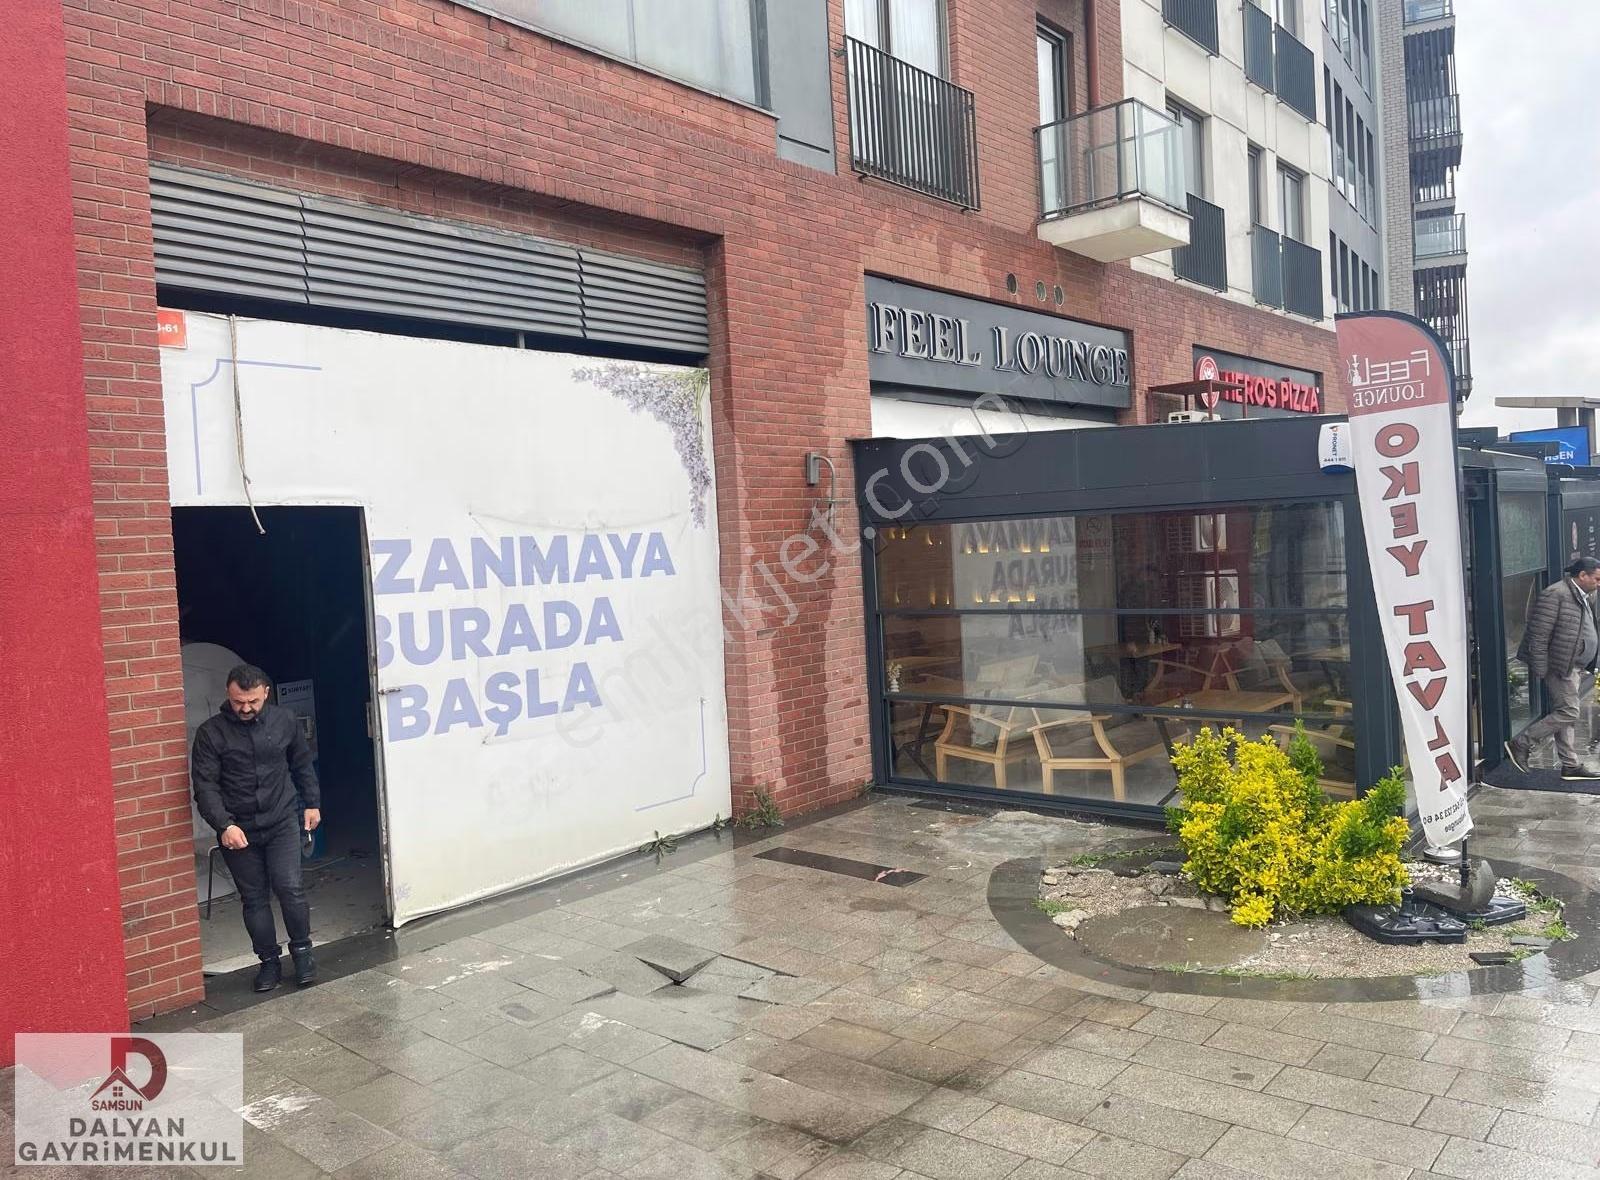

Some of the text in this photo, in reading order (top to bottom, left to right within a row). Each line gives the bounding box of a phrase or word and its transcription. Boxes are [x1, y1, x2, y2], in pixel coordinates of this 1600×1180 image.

[870, 301, 1131, 387] FEEL LOUNGE
[370, 532, 676, 595] ZANMAYA
[385, 661, 604, 743] BAŞLA
